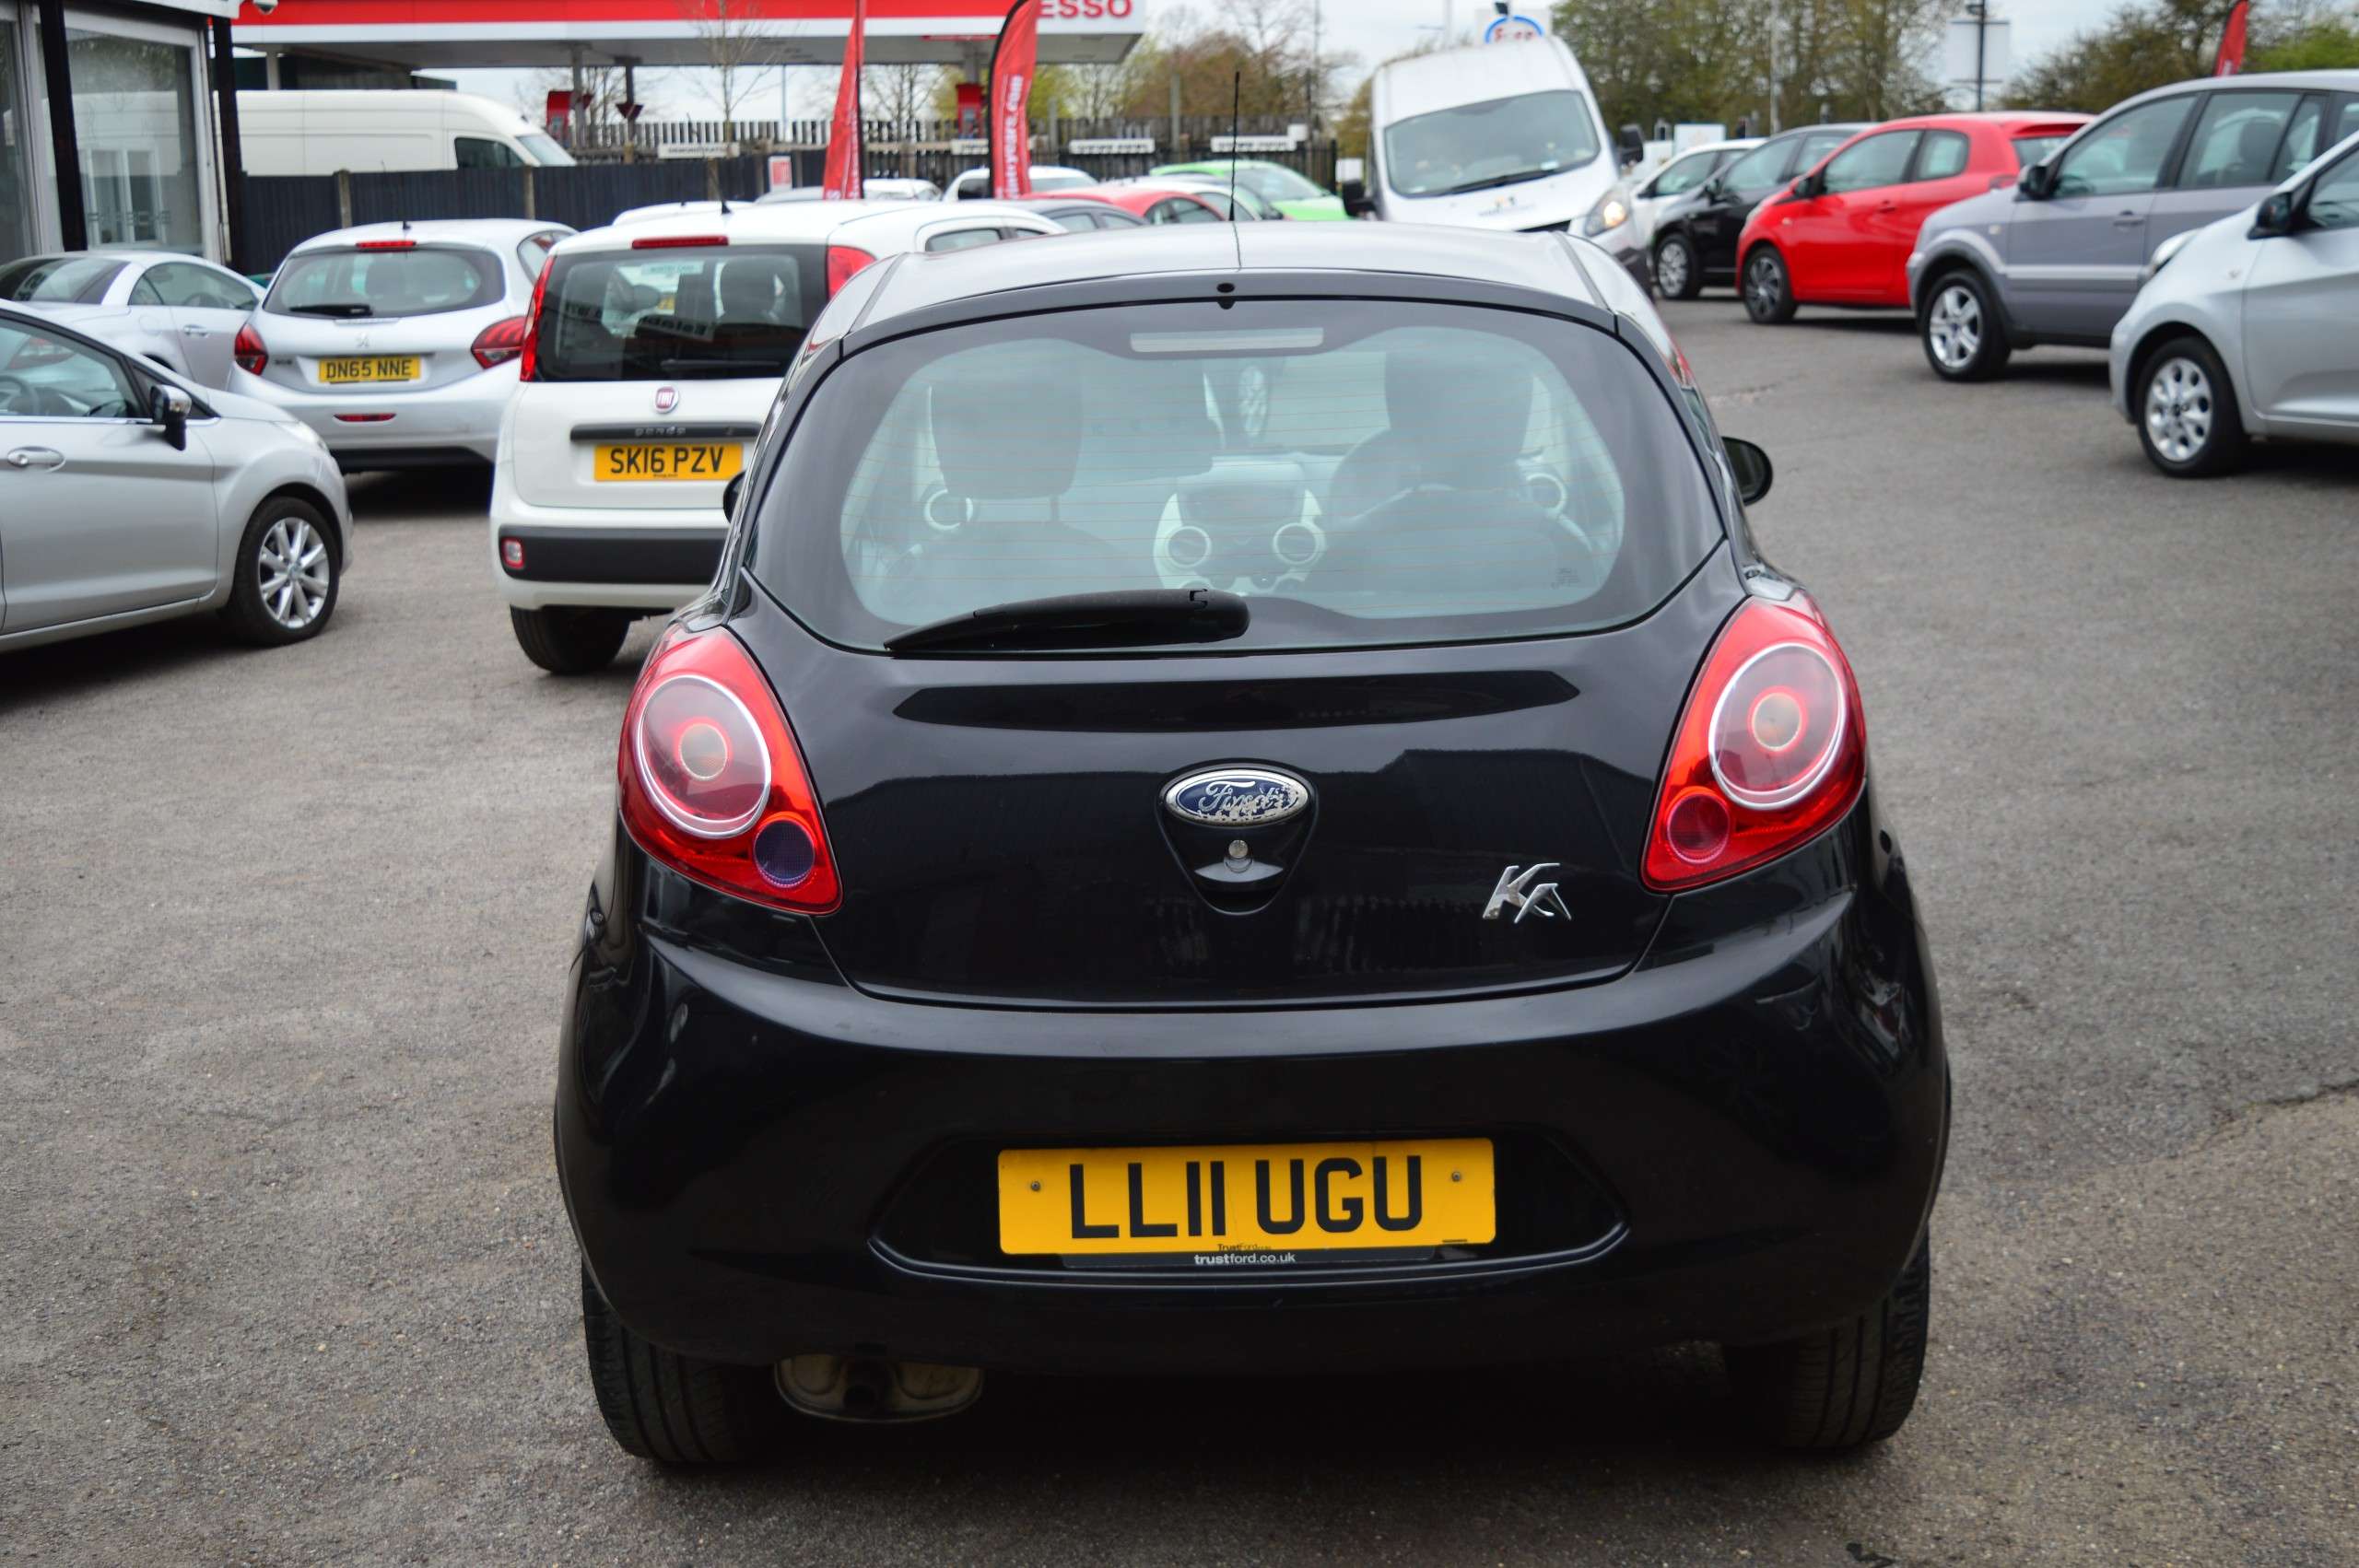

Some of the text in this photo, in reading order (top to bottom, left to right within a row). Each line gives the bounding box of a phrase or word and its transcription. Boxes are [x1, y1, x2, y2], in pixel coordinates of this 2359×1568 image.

[1039, 0, 1133, 18] ESSO
[326, 359, 411, 379] DN65 NNE
[610, 445, 724, 474] SK16 PZV
[1198, 780, 1285, 813] Ford
[1069, 1155, 1423, 1239] LL11 UGU
[1194, 1252, 1297, 1265] trustford.co.uk
